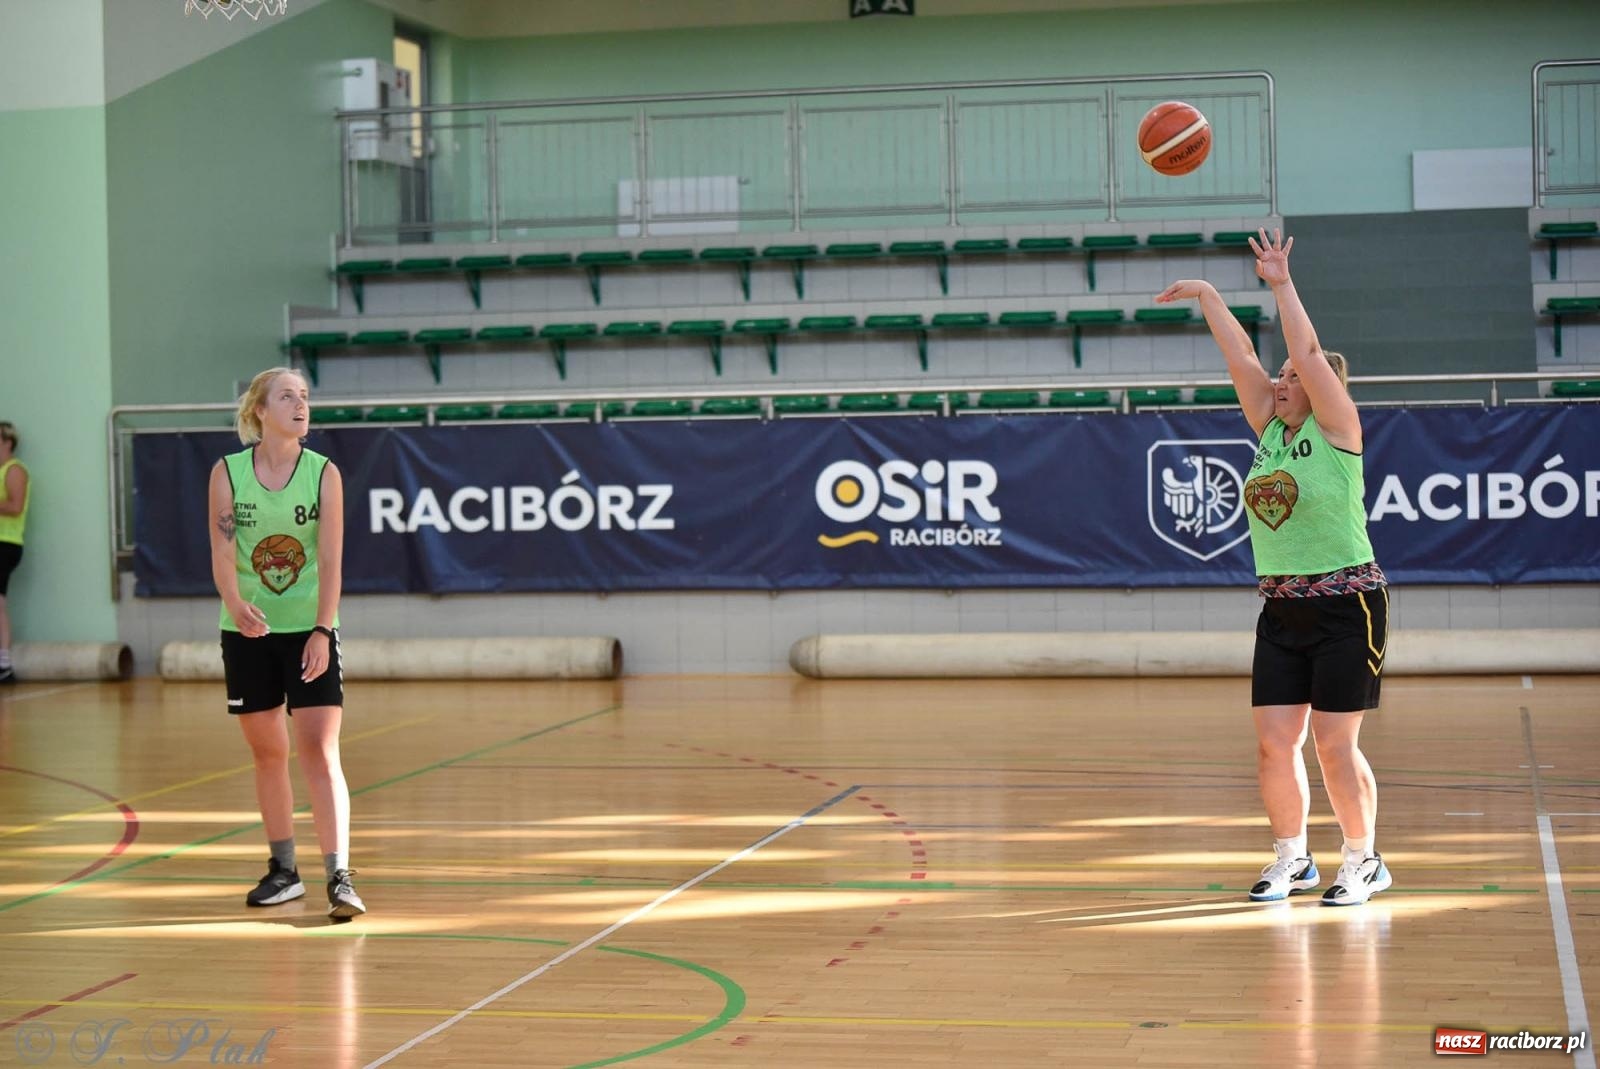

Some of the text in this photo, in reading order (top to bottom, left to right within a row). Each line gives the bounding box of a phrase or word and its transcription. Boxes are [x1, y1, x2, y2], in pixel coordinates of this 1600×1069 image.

[1290, 438, 1313, 460] 40
[369, 468, 675, 533] RACIBÓRZ
[294, 503, 319, 526] 84
[890, 523, 1002, 546] RACIBÓRZ
